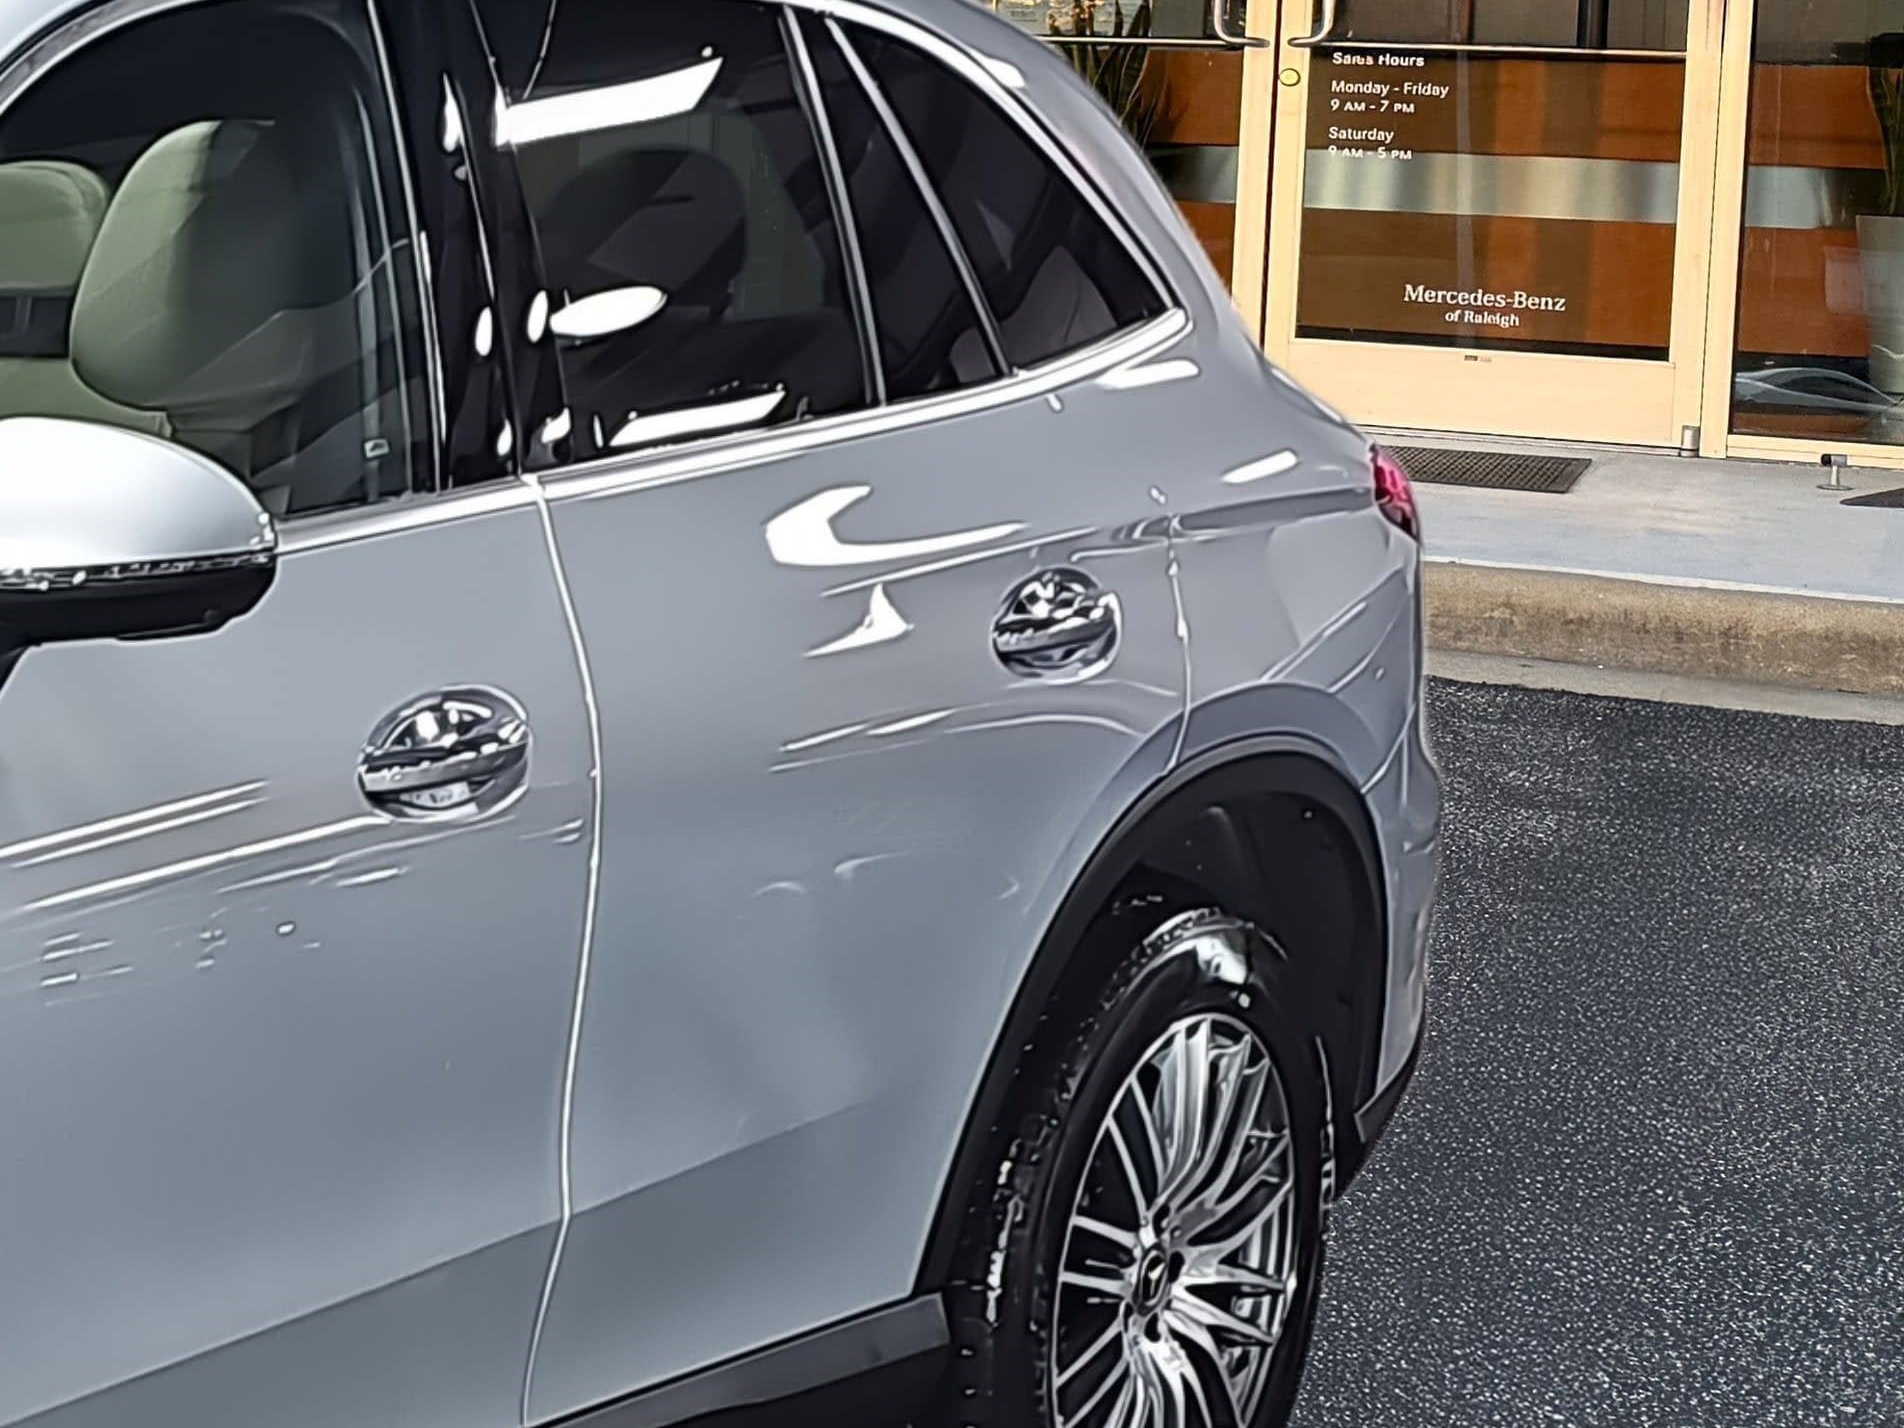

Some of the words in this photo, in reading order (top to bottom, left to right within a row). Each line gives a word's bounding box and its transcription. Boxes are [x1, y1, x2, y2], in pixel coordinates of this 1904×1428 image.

[1378, 53, 1425, 67] Hours
[1331, 80, 1390, 97] Monday
[1403, 82, 1449, 98] Friday
[1330, 99, 1340, 111] 9
[1344, 101, 1366, 112] AM
[1380, 100, 1389, 113] 7
[1394, 103, 1415, 114] PM
[1328, 127, 1394, 144] Saturday
[1328, 145, 1337, 157] 9
[1342, 148, 1363, 158] AM
[1378, 147, 1387, 159] 5
[1392, 149, 1413, 160] PM
[1403, 284, 1566, 312] Mercedes-Benz
[1445, 309, 1461, 322] of
